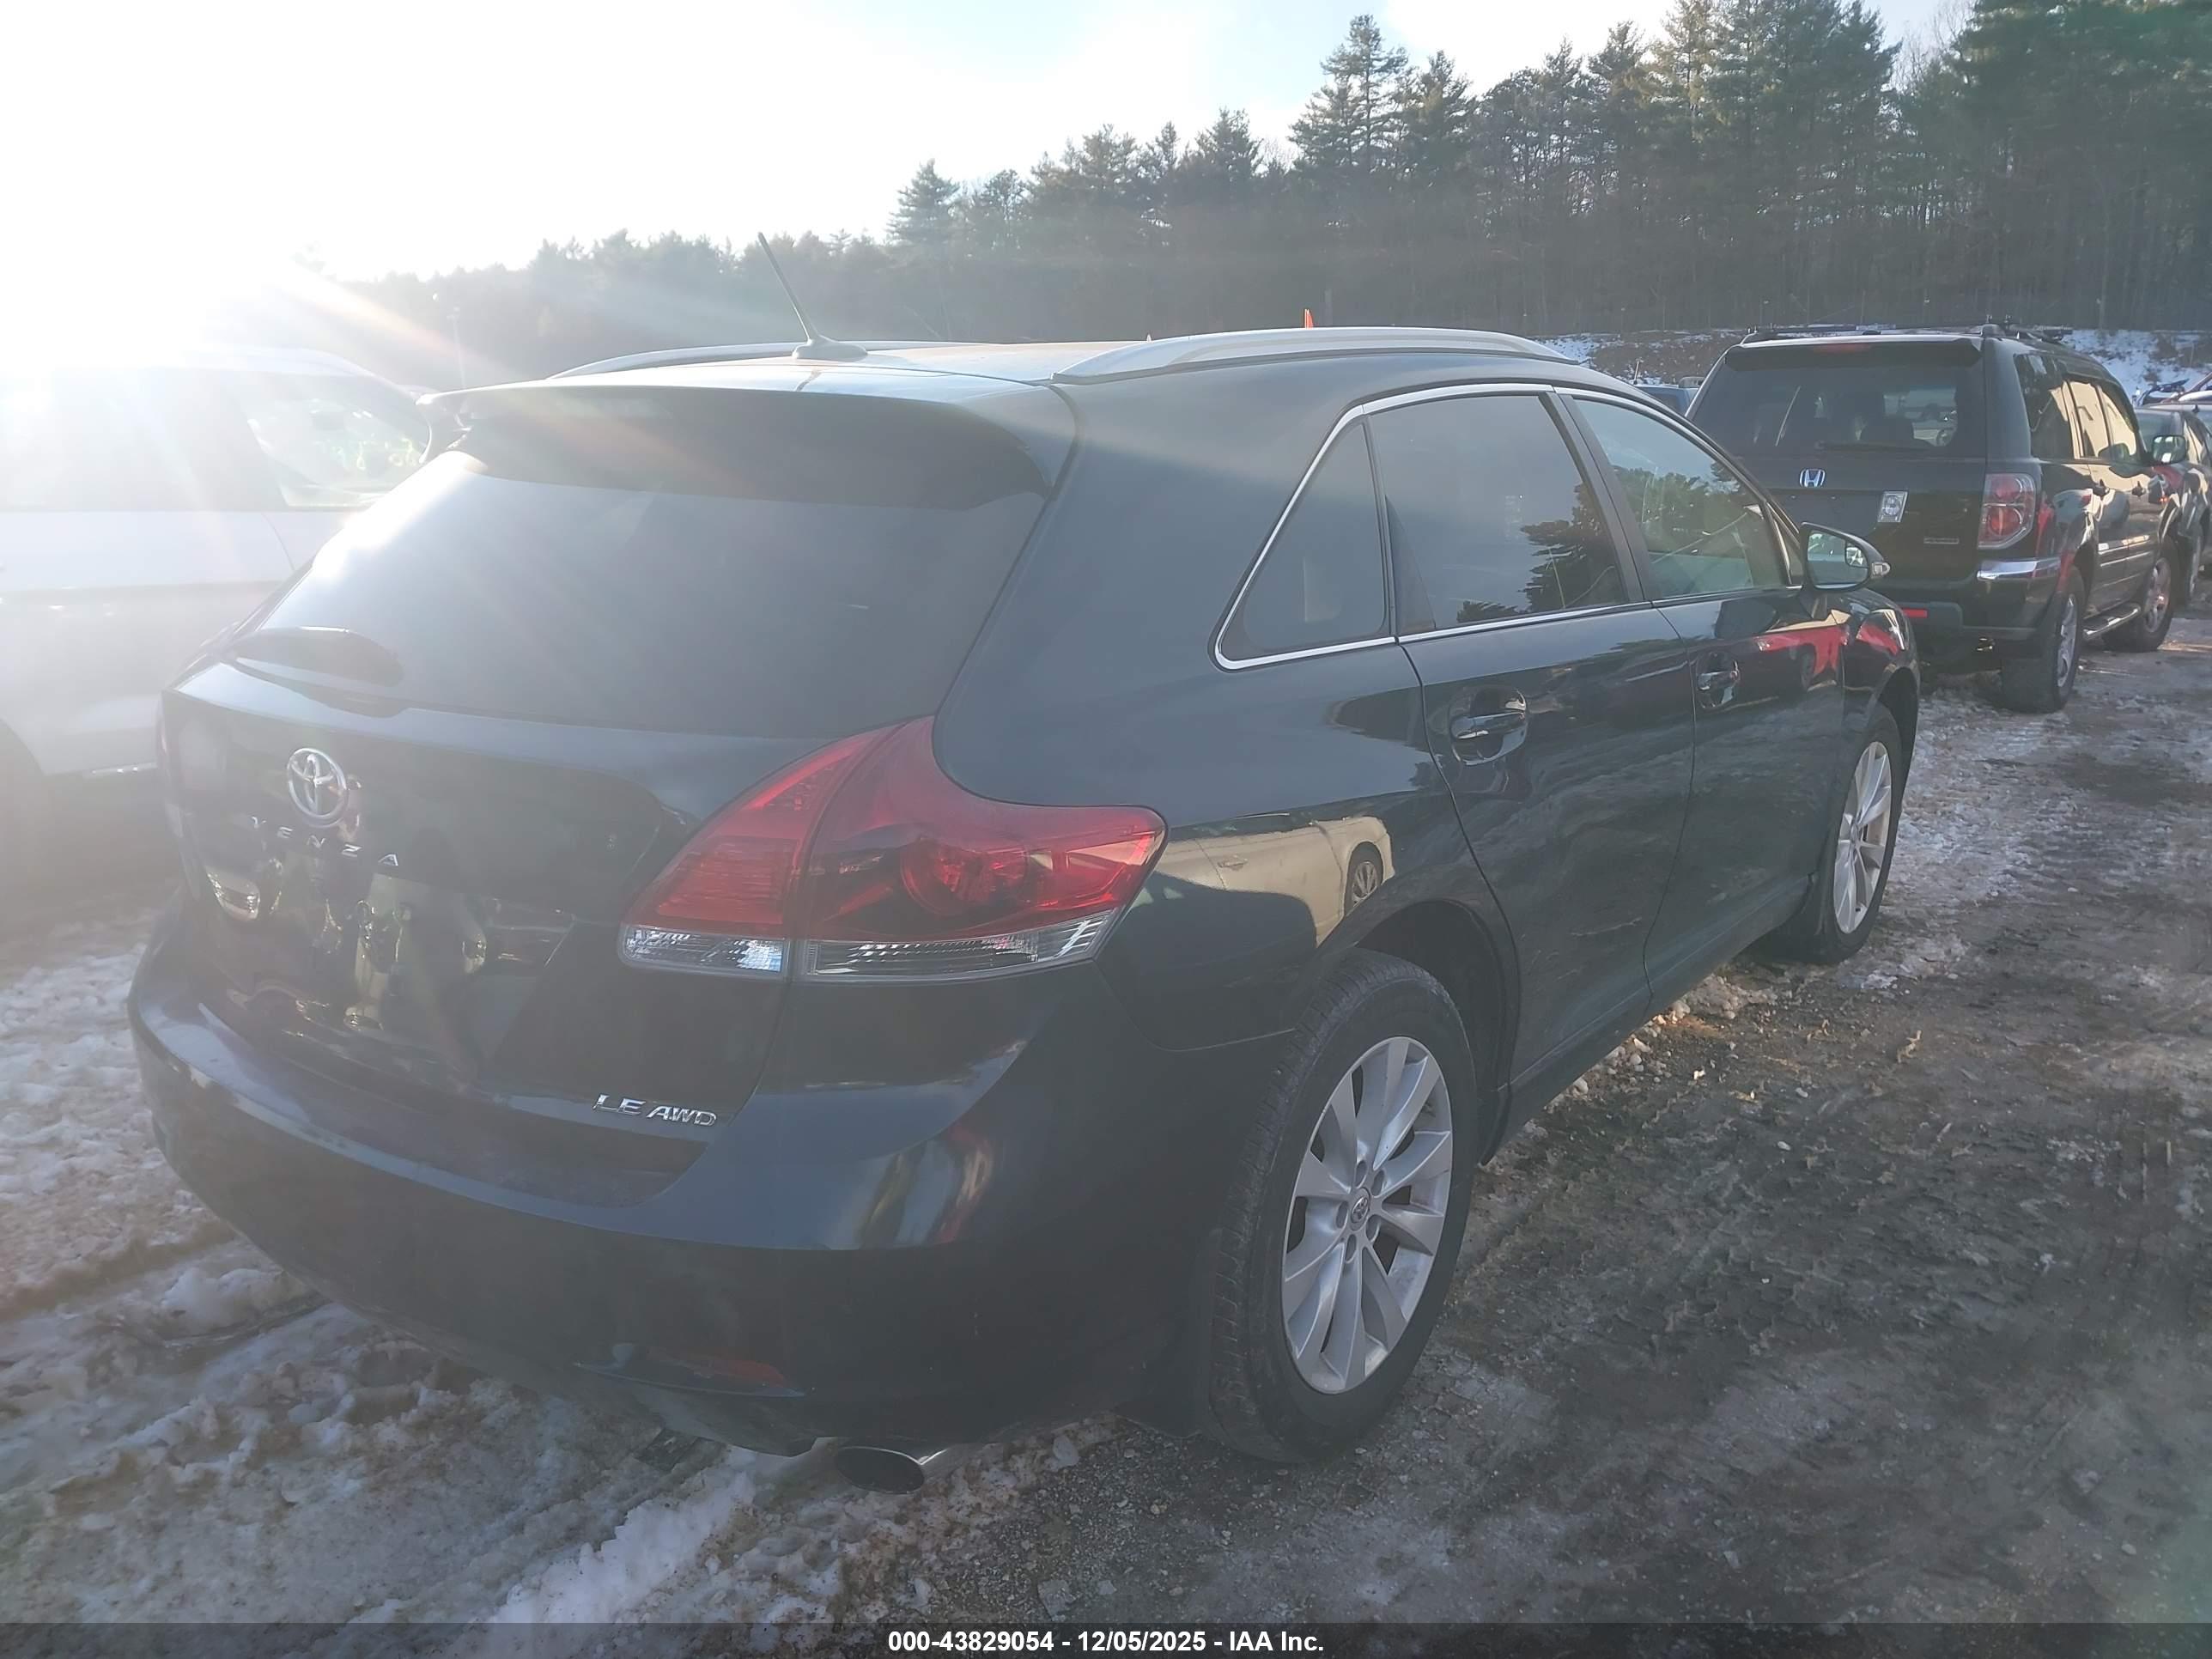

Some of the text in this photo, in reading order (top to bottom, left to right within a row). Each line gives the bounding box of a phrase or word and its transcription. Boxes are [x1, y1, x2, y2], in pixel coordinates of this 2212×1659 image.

[249, 815, 399, 866] VENZA
[592, 1093, 717, 1127] LE AWD
